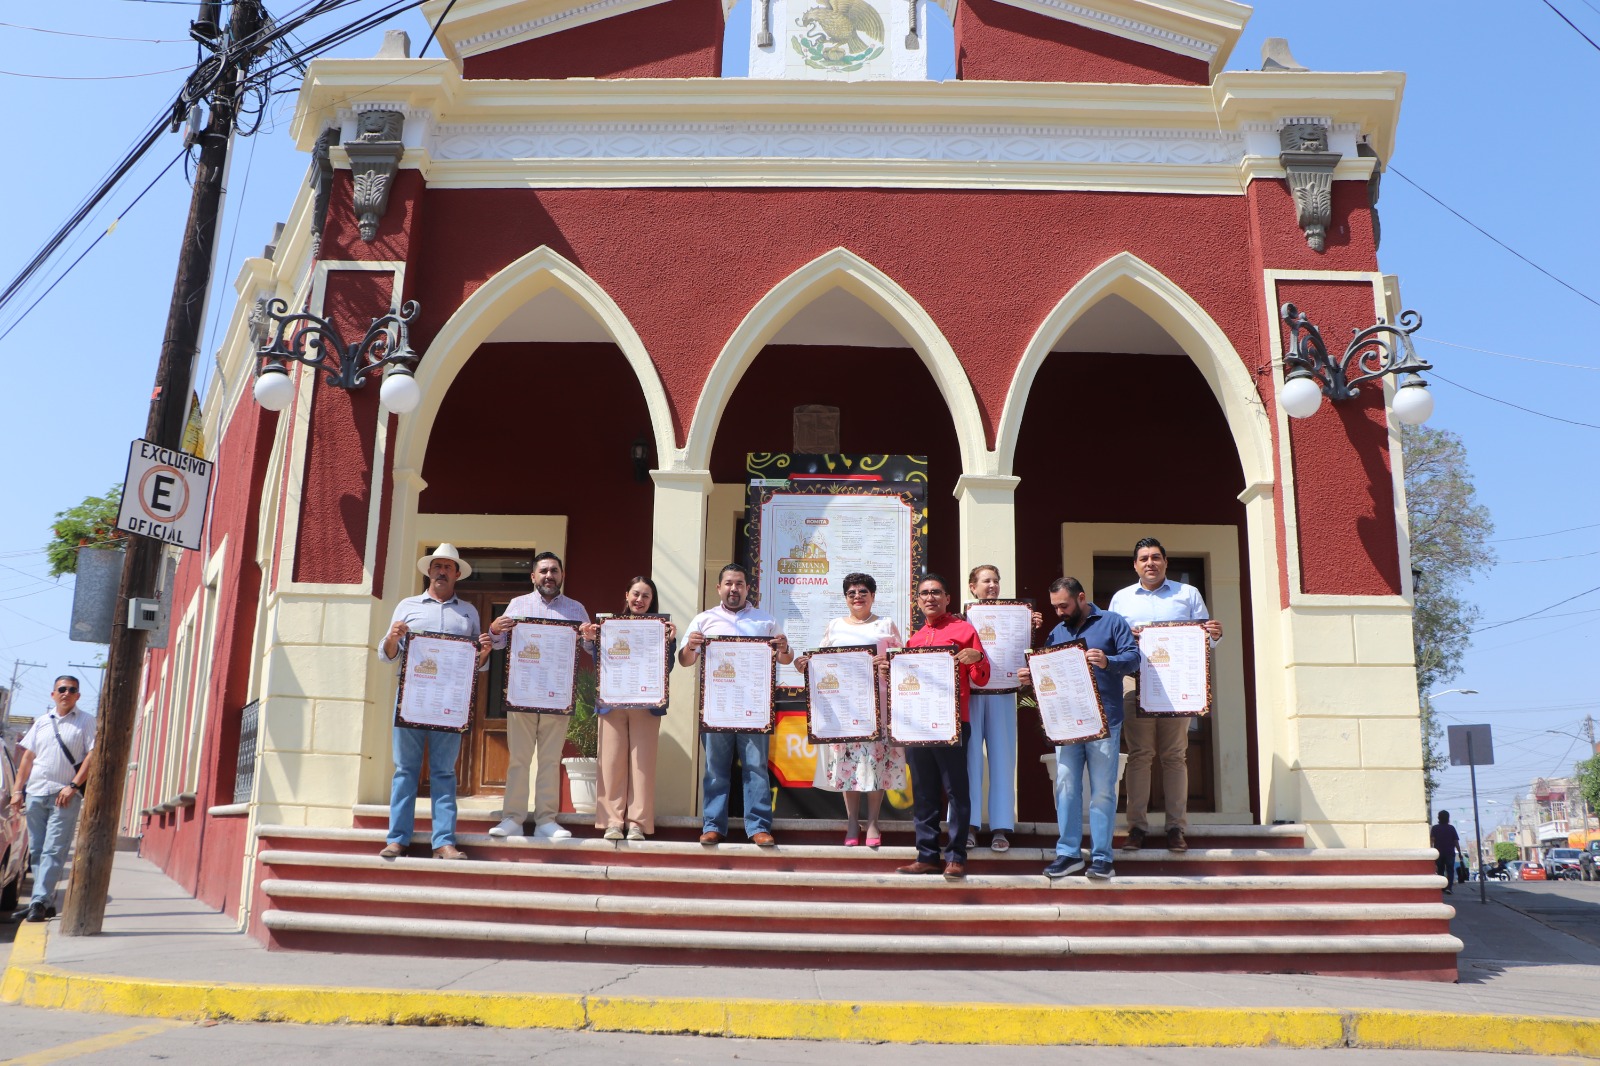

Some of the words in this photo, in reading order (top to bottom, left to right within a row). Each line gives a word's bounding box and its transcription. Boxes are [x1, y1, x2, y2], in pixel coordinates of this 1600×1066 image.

[141, 443, 206, 476] EXCLUSIVO
[151, 474, 175, 512] E
[128, 517, 184, 544] OFICIAL
[778, 577, 829, 585] PROGRAMA
